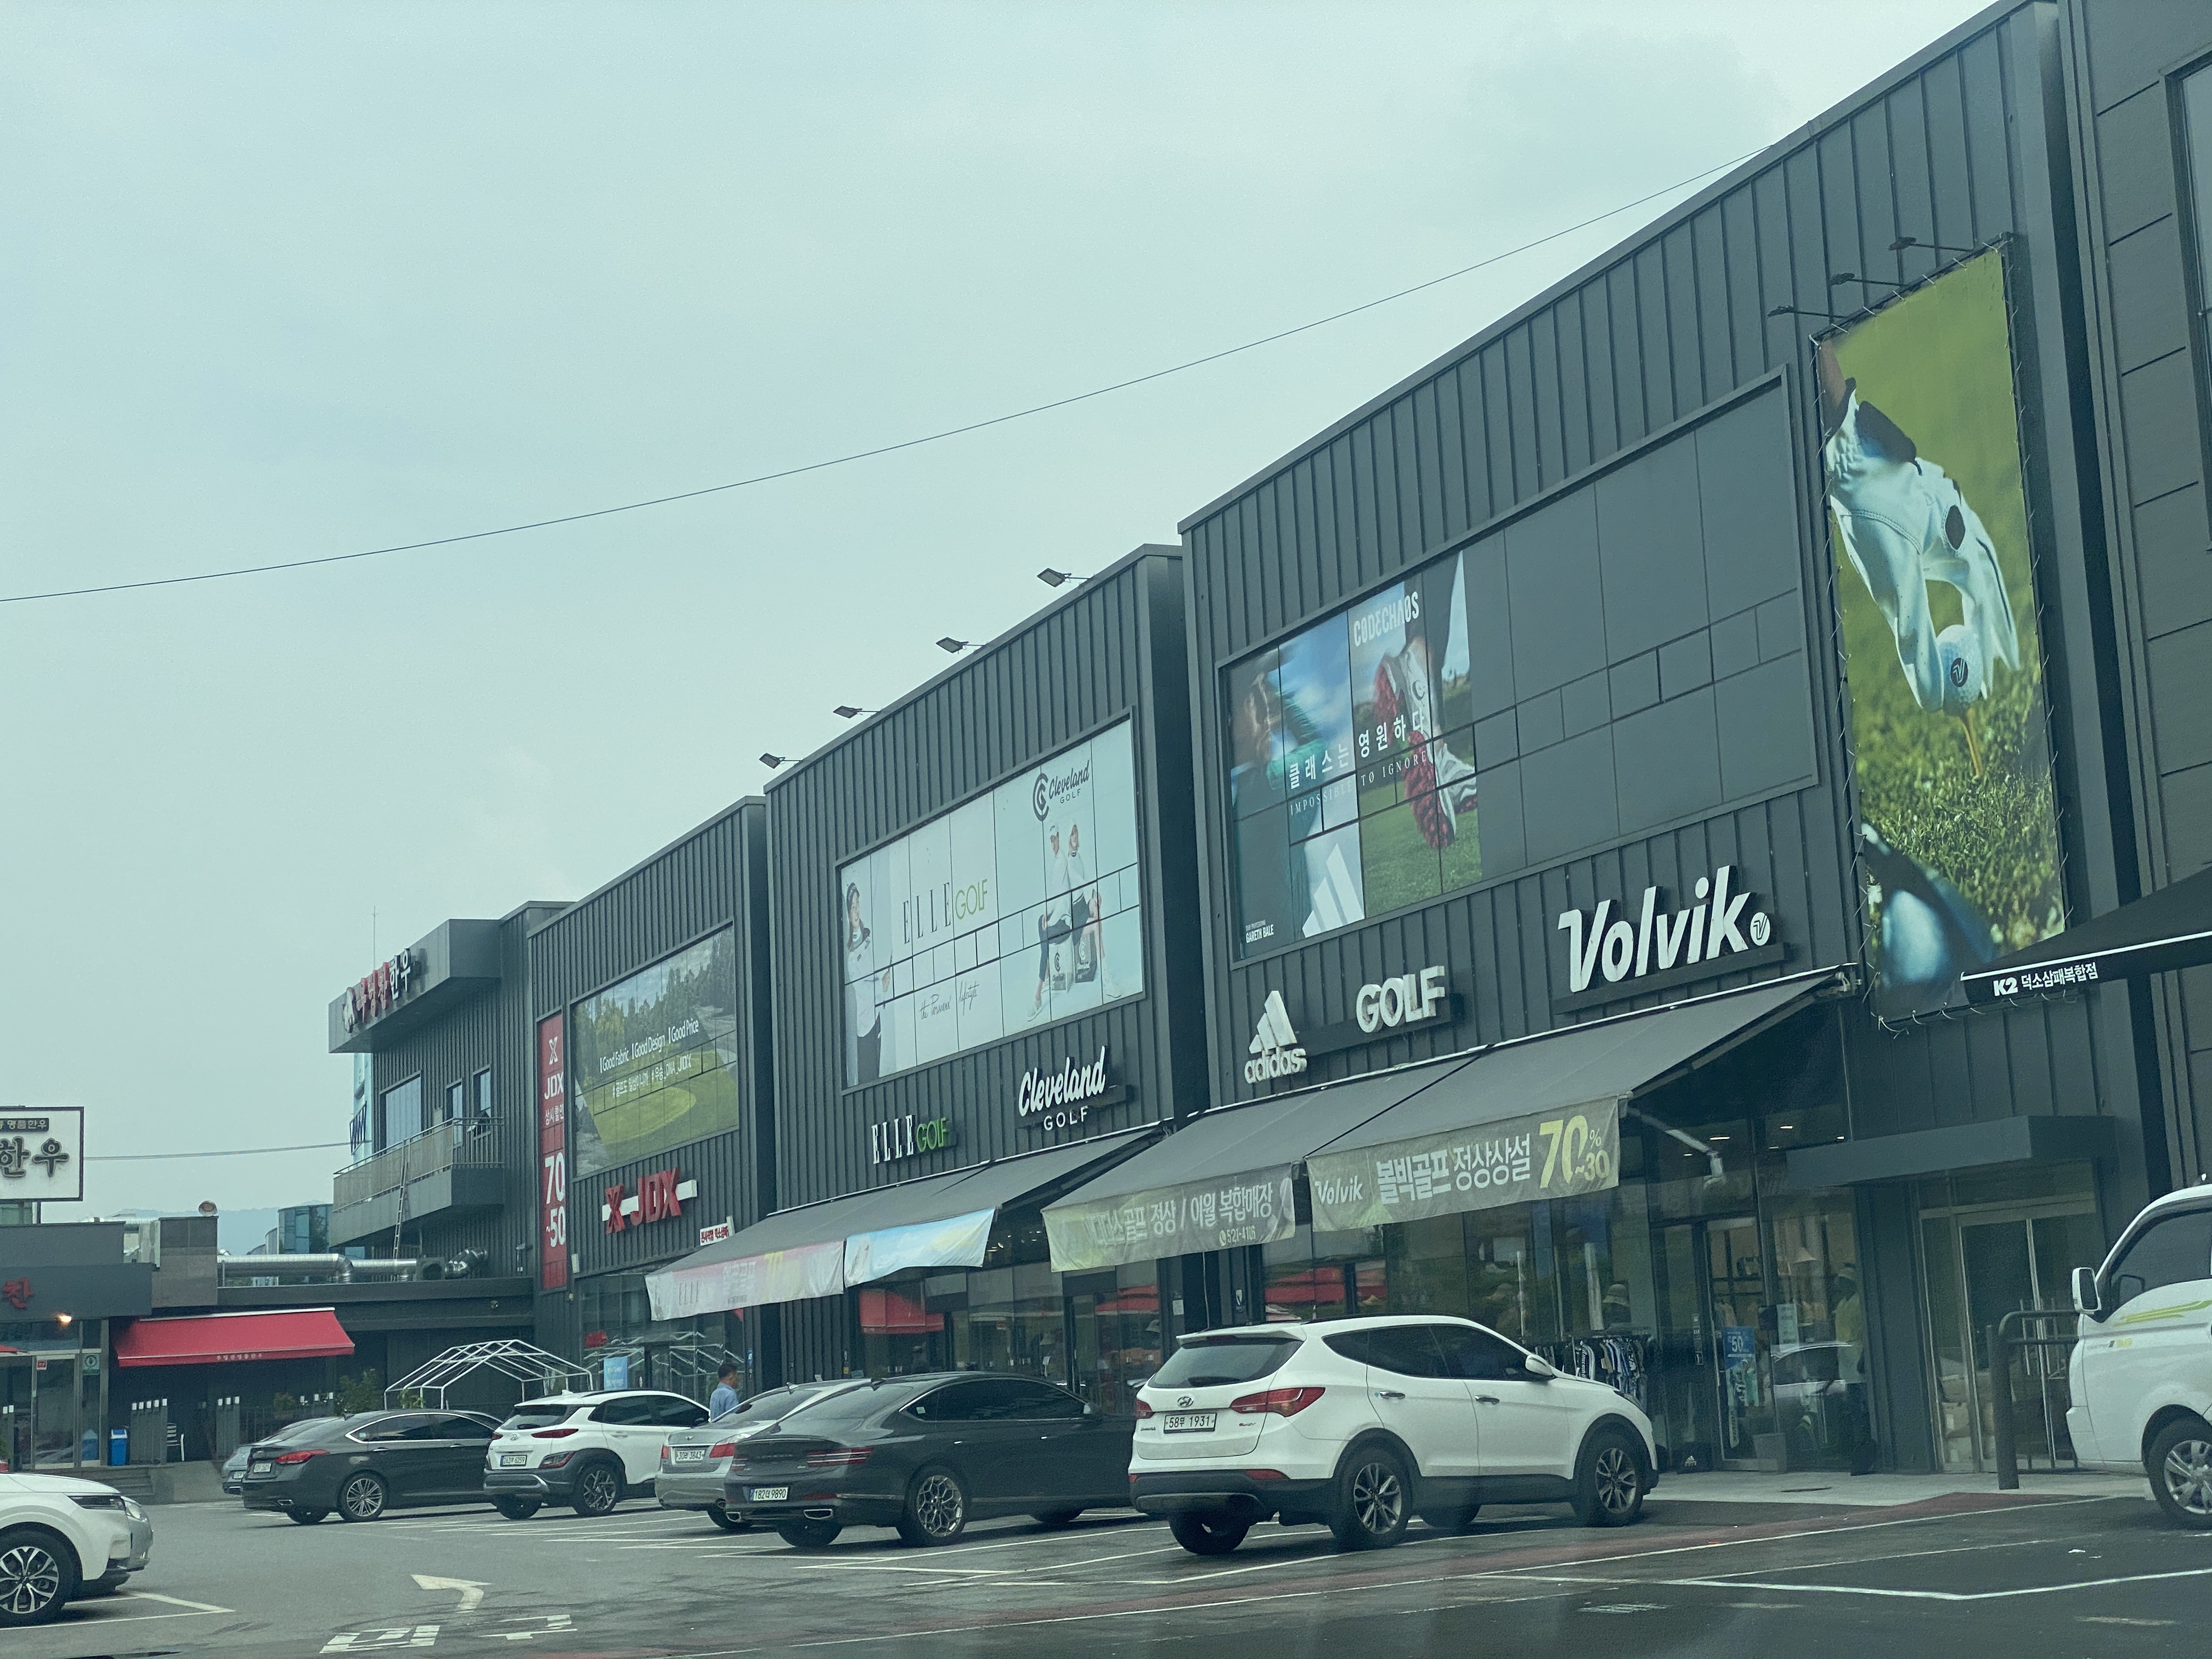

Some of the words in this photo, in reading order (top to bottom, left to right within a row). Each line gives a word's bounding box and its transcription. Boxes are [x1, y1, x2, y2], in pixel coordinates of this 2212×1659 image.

[1289, 744, 1349, 789] 클래스는
[1358, 708, 1425, 758] 영원하다
[1049, 760, 1090, 799] Cleveland
[1060, 788, 1081, 804] GOLF
[1291, 781, 1353, 816] IMPOSSIBLE
[1383, 751, 1426, 777] IGNORE
[903, 882, 951, 944] ELLE
[955, 879, 988, 920] GOLF
[1246, 928, 1262, 944] GARETH
[1262, 924, 1274, 938] BALE
[1558, 865, 1751, 992] Volvik
[1356, 966, 1445, 1033] GOLF
[1993, 977, 2018, 996] K2
[2021, 962, 2098, 990] 덕소삼패복합점
[603, 1051, 615, 1071] Good
[615, 1047, 629, 1067] Fabric
[634, 1037, 648, 1058] Good
[648, 1034, 665, 1053] Design
[671, 1020, 685, 1042] Good
[686, 1018, 699, 1036] Price
[1244, 1046, 1307, 1084] adidas
[544, 1071, 563, 1100] JDX
[1018, 1045, 1106, 1117] Cleveland
[871, 1115, 914, 1165] ELLE
[917, 1117, 947, 1153] GOLF
[1043, 1105, 1088, 1131] GOLF
[544, 1152, 565, 1205] 70
[1314, 1175, 1363, 1205] Volvik
[1376, 1149, 1452, 1205] 볼빅골프
[1453, 1133, 1531, 1191] 정상상설
[630, 1167, 681, 1226] JDX
[1150, 1200, 1176, 1235] 정상
[1190, 1192, 1217, 1227] 이월
[1219, 1182, 1273, 1223] 복합매장
[1189, 1415, 1210, 1427] 1931
[771, 1488, 786, 1499] 9890
